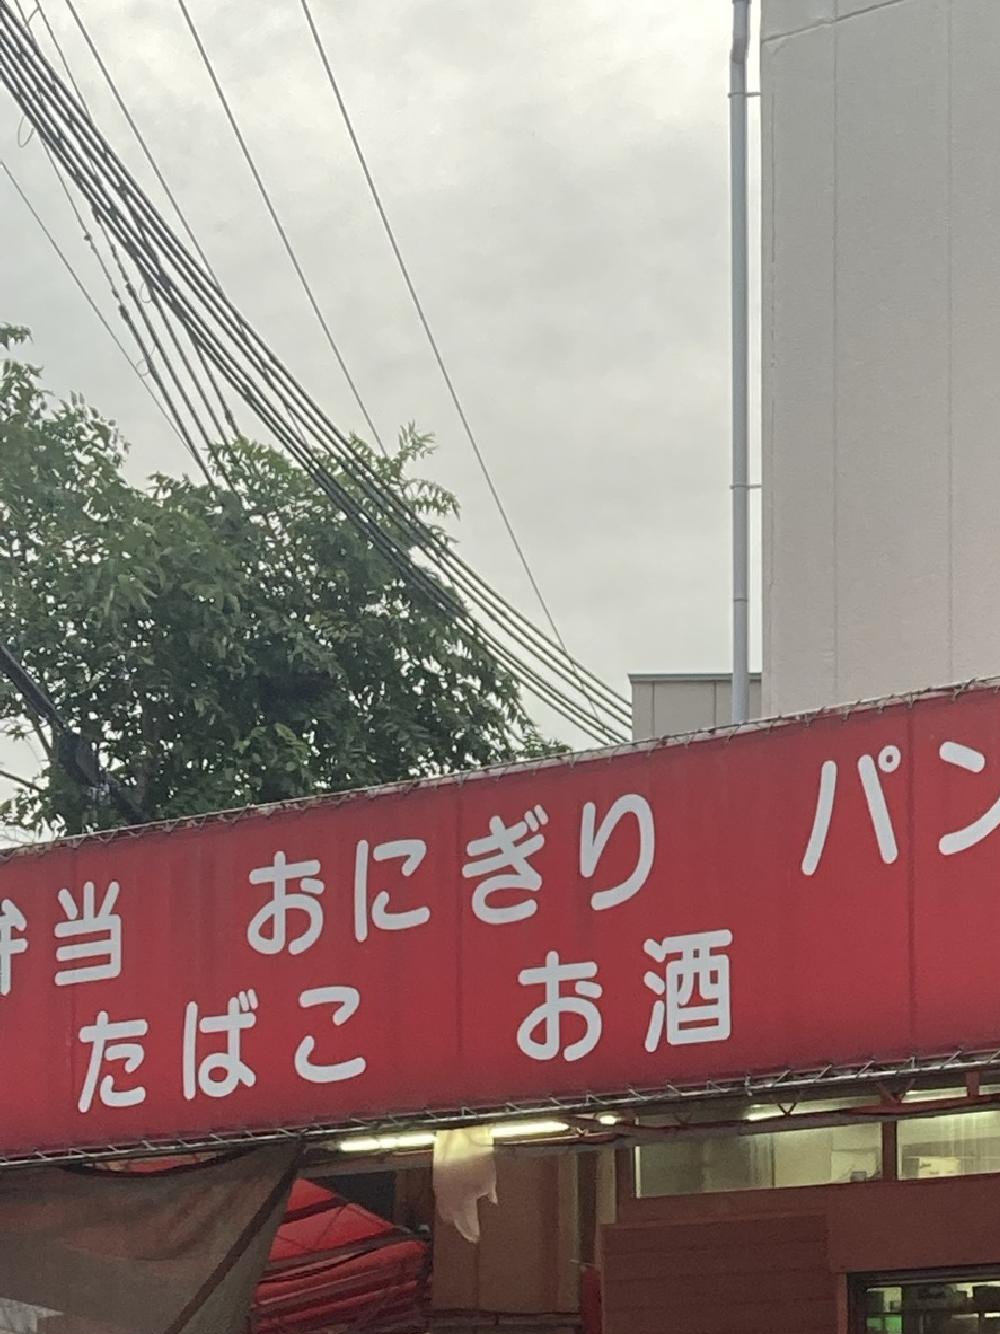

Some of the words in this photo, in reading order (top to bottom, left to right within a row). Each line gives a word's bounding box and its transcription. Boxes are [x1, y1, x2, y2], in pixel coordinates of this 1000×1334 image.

[247, 793, 655, 955] おにぎり
[78, 986, 366, 1113] たばこ
[516, 929, 733, 1061] お酒
